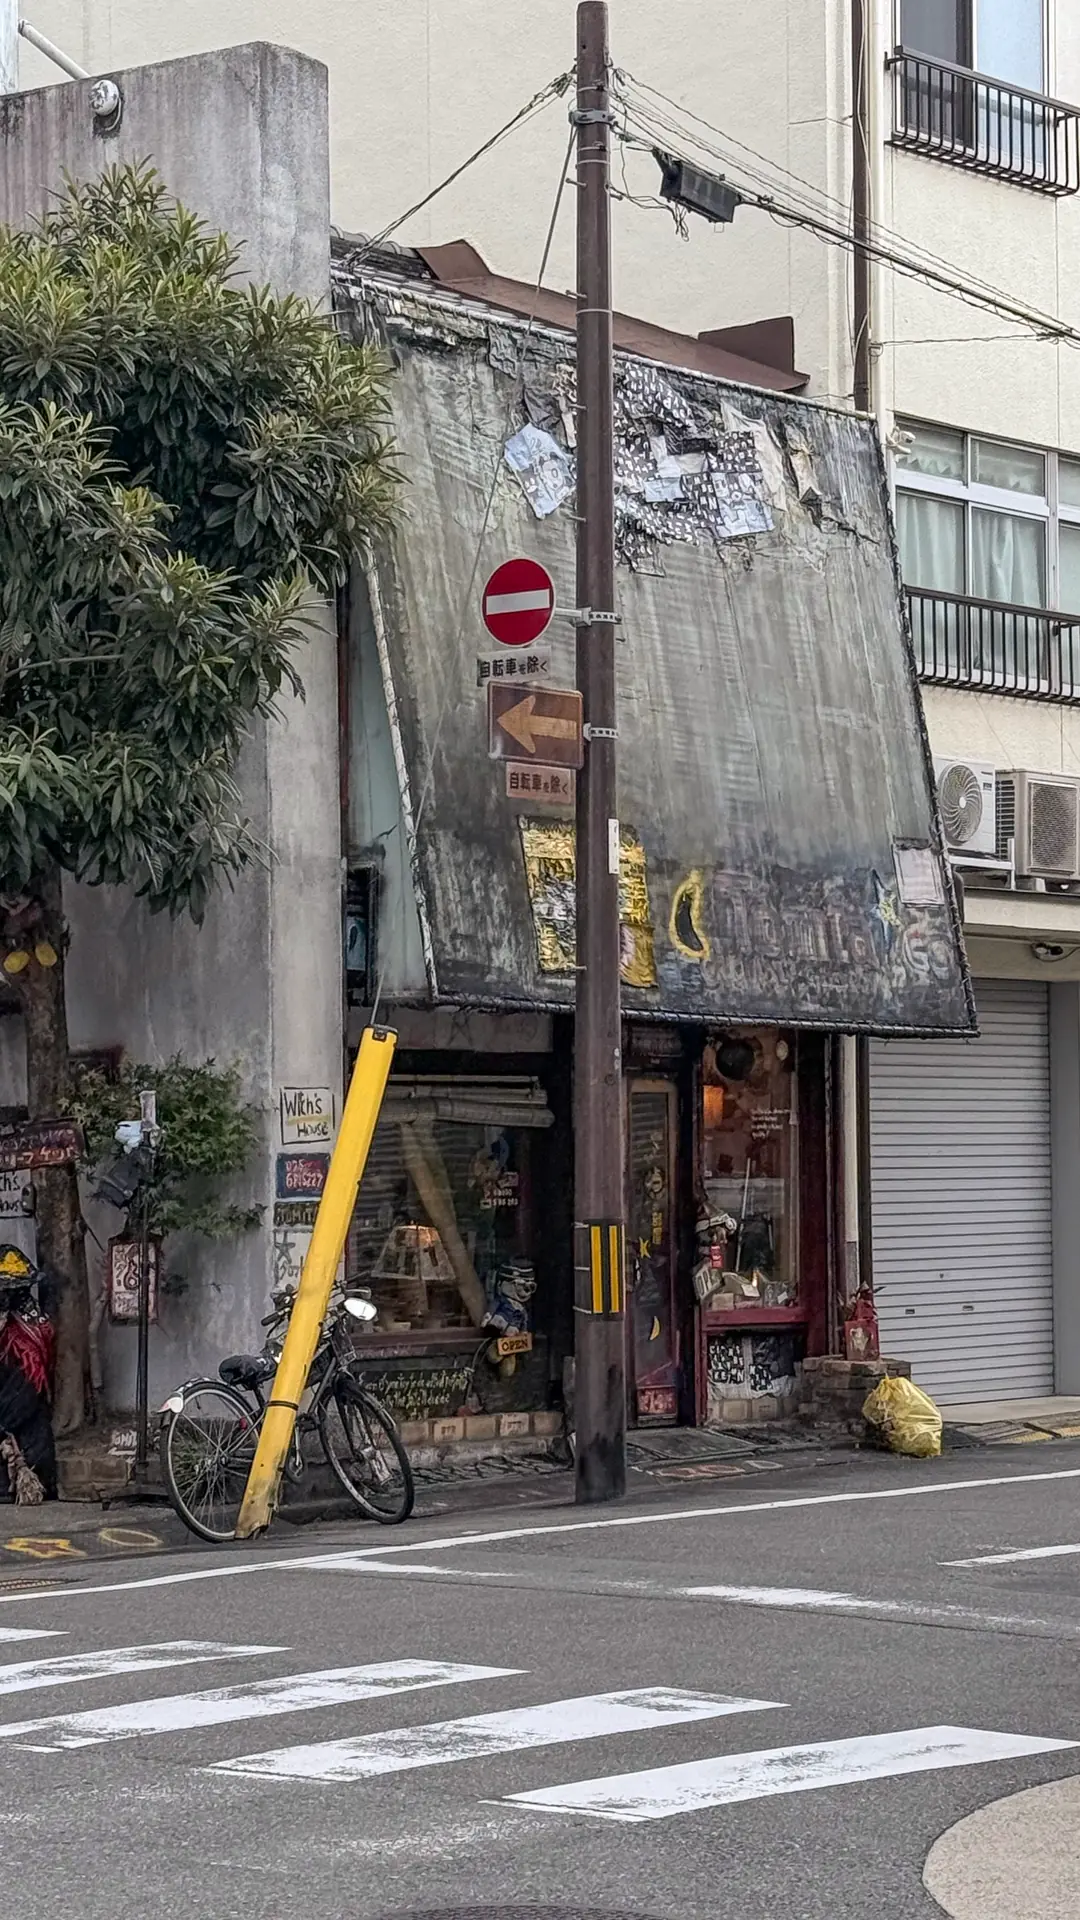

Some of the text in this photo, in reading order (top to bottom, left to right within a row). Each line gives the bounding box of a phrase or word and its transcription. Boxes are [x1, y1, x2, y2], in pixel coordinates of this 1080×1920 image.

[480, 655, 548, 679] 自転車を除く
[509, 772, 568, 795] 自転車を除く
[502, 1337, 528, 1351] OPEN
